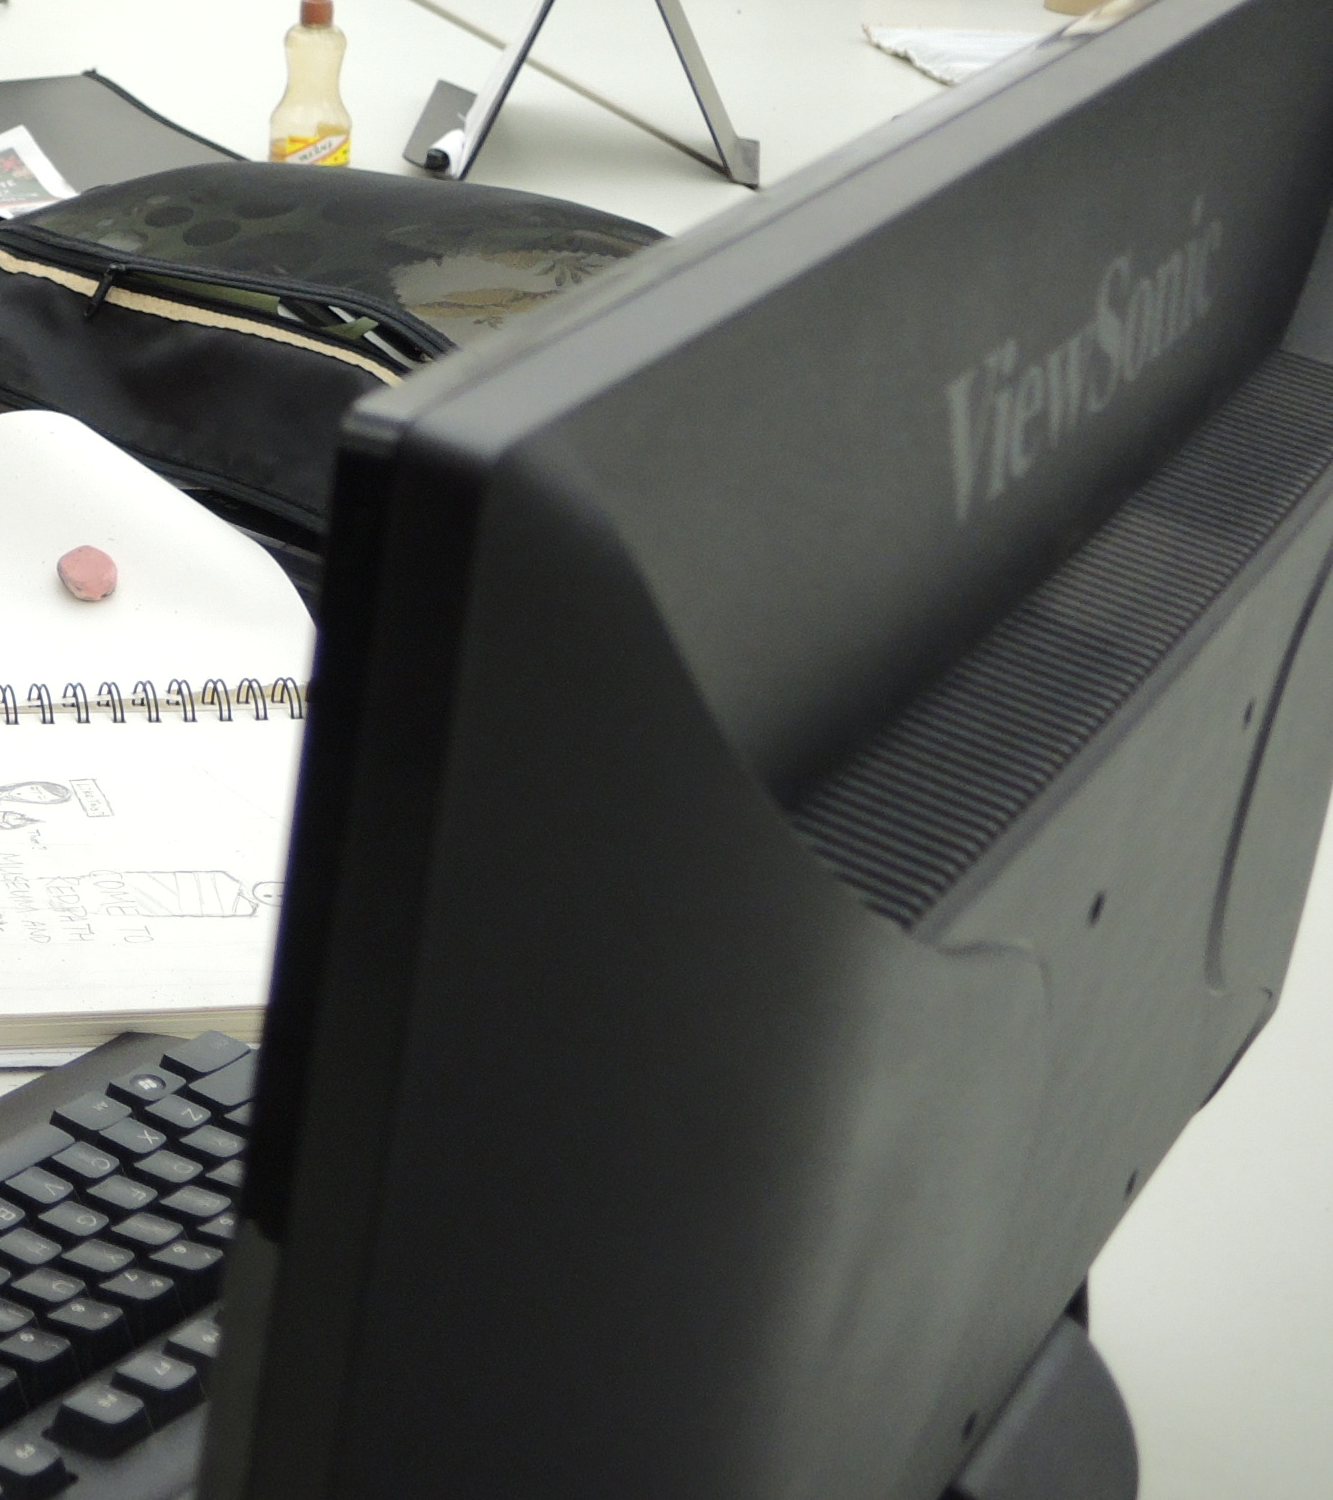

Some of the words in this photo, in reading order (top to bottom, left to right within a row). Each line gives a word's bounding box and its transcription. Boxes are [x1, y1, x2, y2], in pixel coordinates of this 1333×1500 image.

[944, 194, 1225, 524] ViewSonic
[88, 870, 141, 918] COME
[118, 924, 155, 943] TO
[20, 919, 52, 944] AND
[181, 1108, 201, 1121] Z
[137, 1130, 159, 1145] X
[91, 1157, 110, 1170] C
[44, 1182, 65, 1195] V
[128, 1187, 147, 1200] F
[76, 1215, 97, 1227] G
